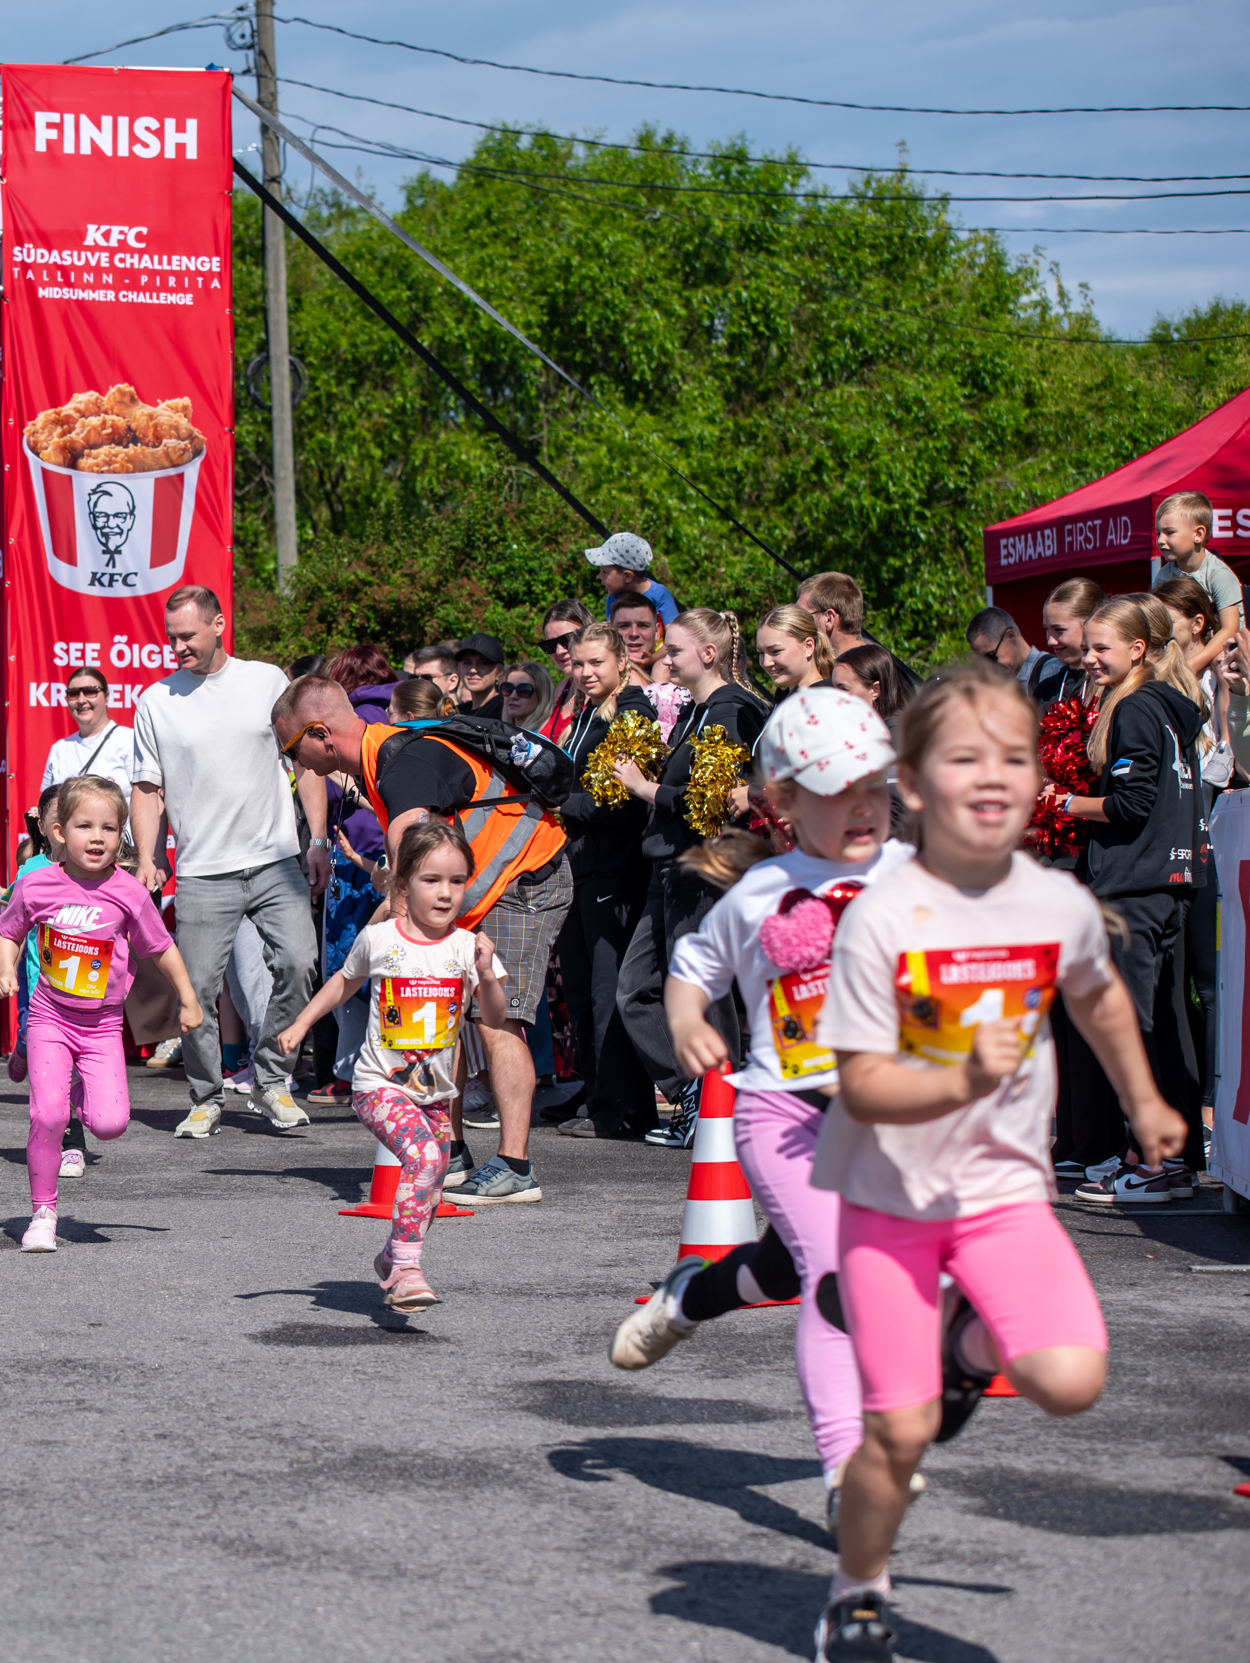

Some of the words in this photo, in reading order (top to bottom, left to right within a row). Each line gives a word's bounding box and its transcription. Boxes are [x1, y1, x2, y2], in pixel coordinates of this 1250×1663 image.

[34, 111, 198, 160] FINISH
[83, 224, 148, 248] KFC
[12, 243, 110, 268] SÜDASUVE
[113, 253, 221, 272] CHALLENGE
[12, 268, 113, 285] TALLINN
[141, 275, 221, 289] PIRITA
[38, 287, 116, 302] MIDSUMMER
[118, 291, 194, 306] CHALLENGE
[1000, 527, 1057, 567] ESMAABI
[1064, 519, 1103, 554] FIRST
[1106, 516, 1131, 547] AID
[87, 571, 139, 588] KFC
[53, 641, 101, 668] SEE
[110, 635, 179, 669] ÕIGE
[55, 904, 103, 927] NIKE
[53, 938, 100, 956] LASTEJOOKS
[59, 955, 81, 990] 1
[400, 986, 456, 998] LASTEJOOKS
[412, 1002, 436, 1044] 1
